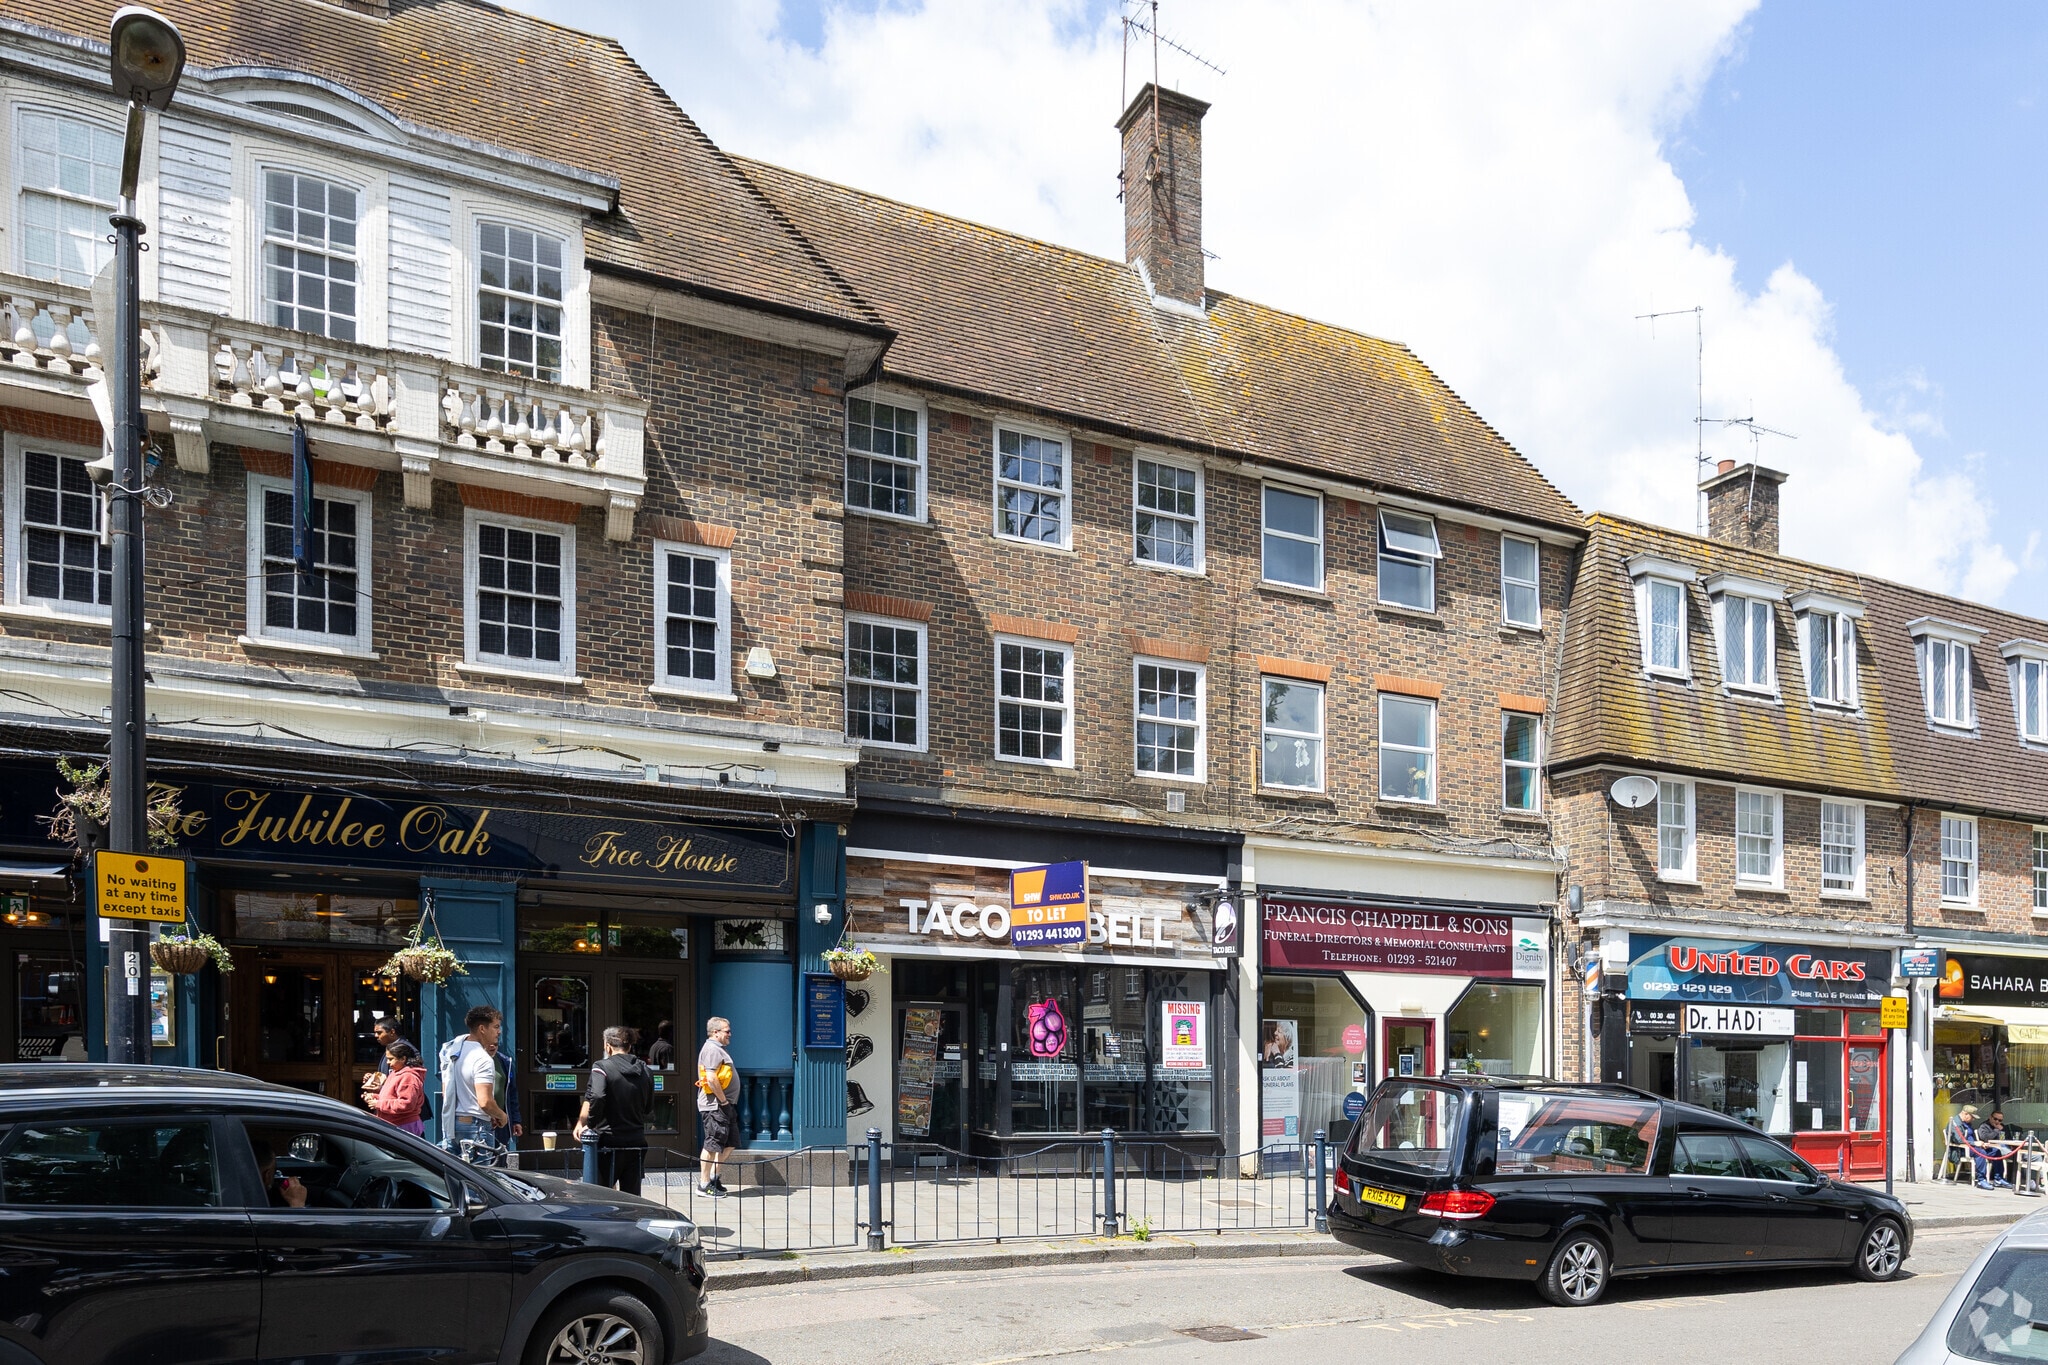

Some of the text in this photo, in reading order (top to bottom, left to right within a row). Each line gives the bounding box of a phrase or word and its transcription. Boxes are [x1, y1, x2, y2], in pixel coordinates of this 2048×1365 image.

[221, 789, 385, 848] Jubilee
[400, 805, 491, 856] Oak
[579, 831, 738, 873] Free House
[107, 874, 176, 892] No waiting
[106, 888, 177, 902] at any time
[1023, 892, 1040, 903] SHW
[104, 903, 181, 916] except taxis
[1027, 907, 1067, 922] TO LET
[900, 899, 1173, 948] TACO BELL
[1264, 904, 1508, 936] FRANCIS CHAPPELL & SONS
[1015, 926, 1082, 942] 01293 441300
[1264, 929, 1506, 953] FUNERAL DIRECTORS & MEMORIAL CONSULTANTS
[1387, 953, 1415, 964] 01293
[1425, 956, 1457, 966] 521407
[1516, 951, 1543, 964] Dignity
[1790, 954, 1866, 981] CARS
[1642, 982, 1732, 994] 01293 429 429
[1971, 975, 2034, 992] SAHARA
[1168, 1003, 1200, 1014] MISSING
[1690, 1008, 1711, 1030] Dr.
